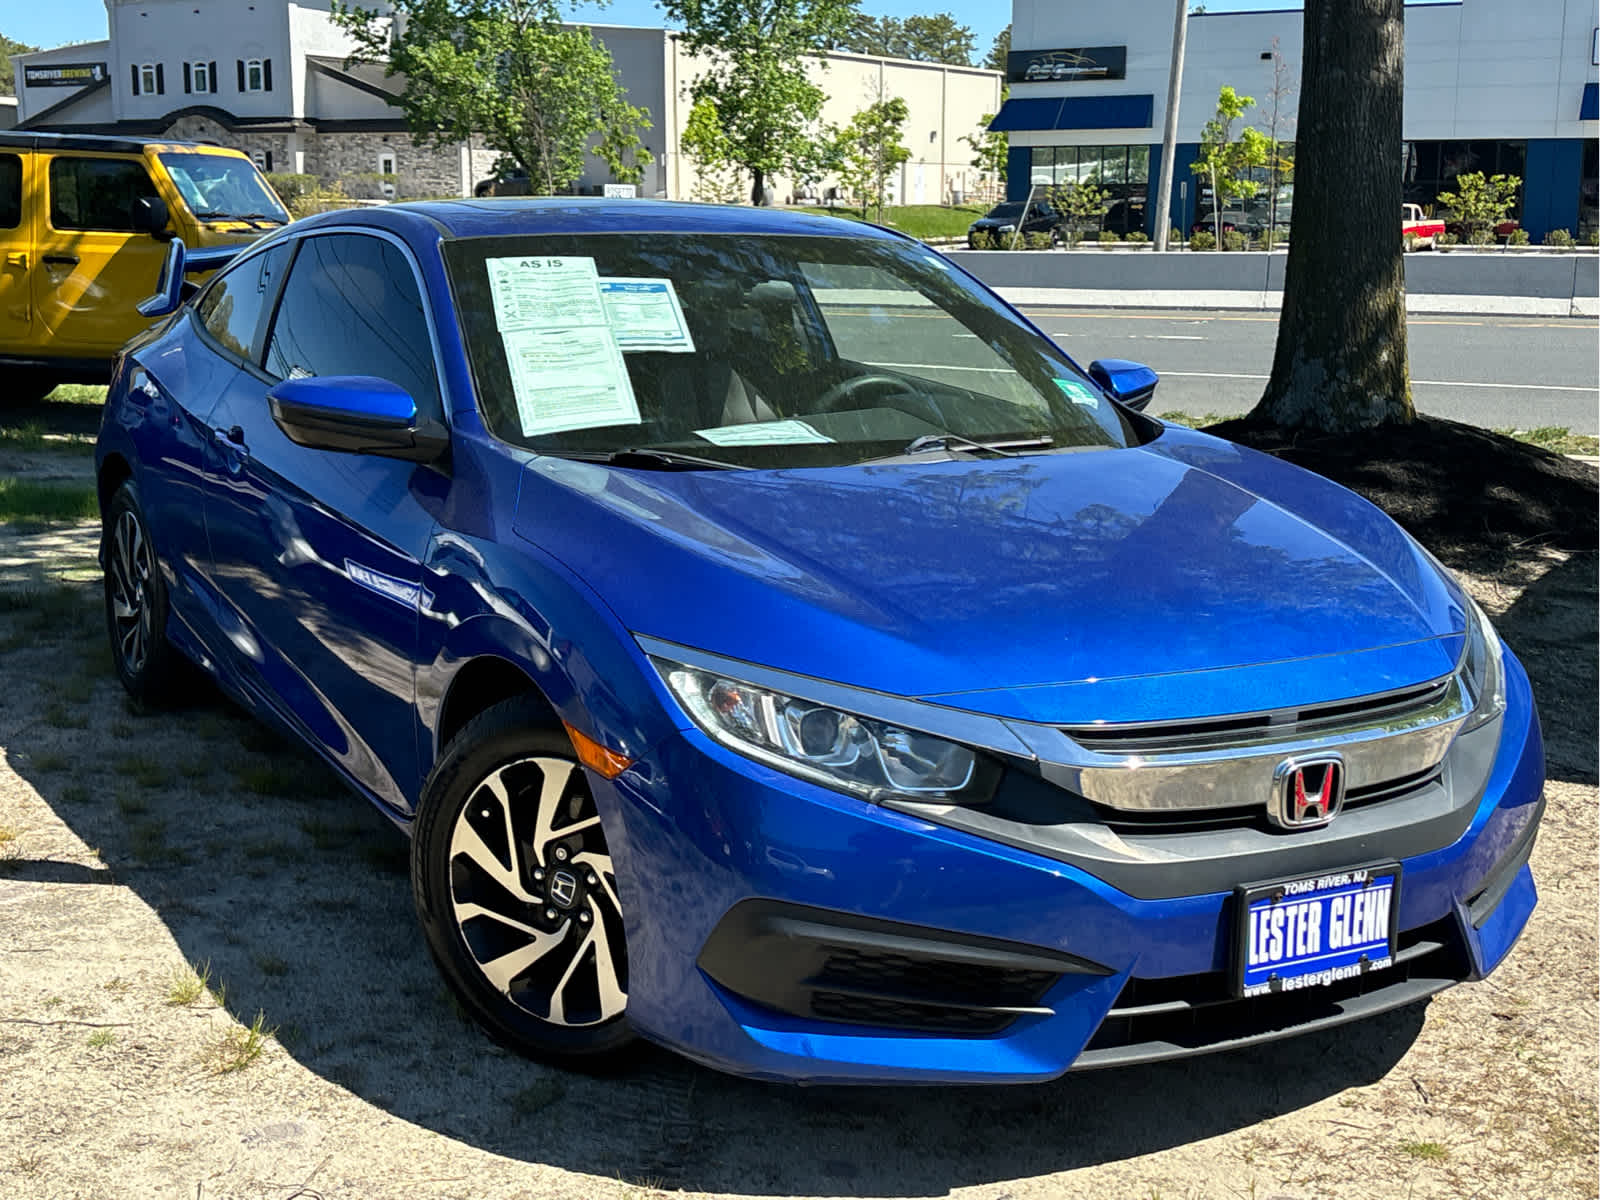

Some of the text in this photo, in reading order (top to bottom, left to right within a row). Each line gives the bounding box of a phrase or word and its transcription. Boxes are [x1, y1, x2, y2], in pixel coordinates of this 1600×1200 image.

[519, 259, 563, 268] AS IS
[1284, 880, 1315, 895] TOMS
[1353, 870, 1368, 883] NJ
[1249, 888, 1392, 966] LESTER GLENN
